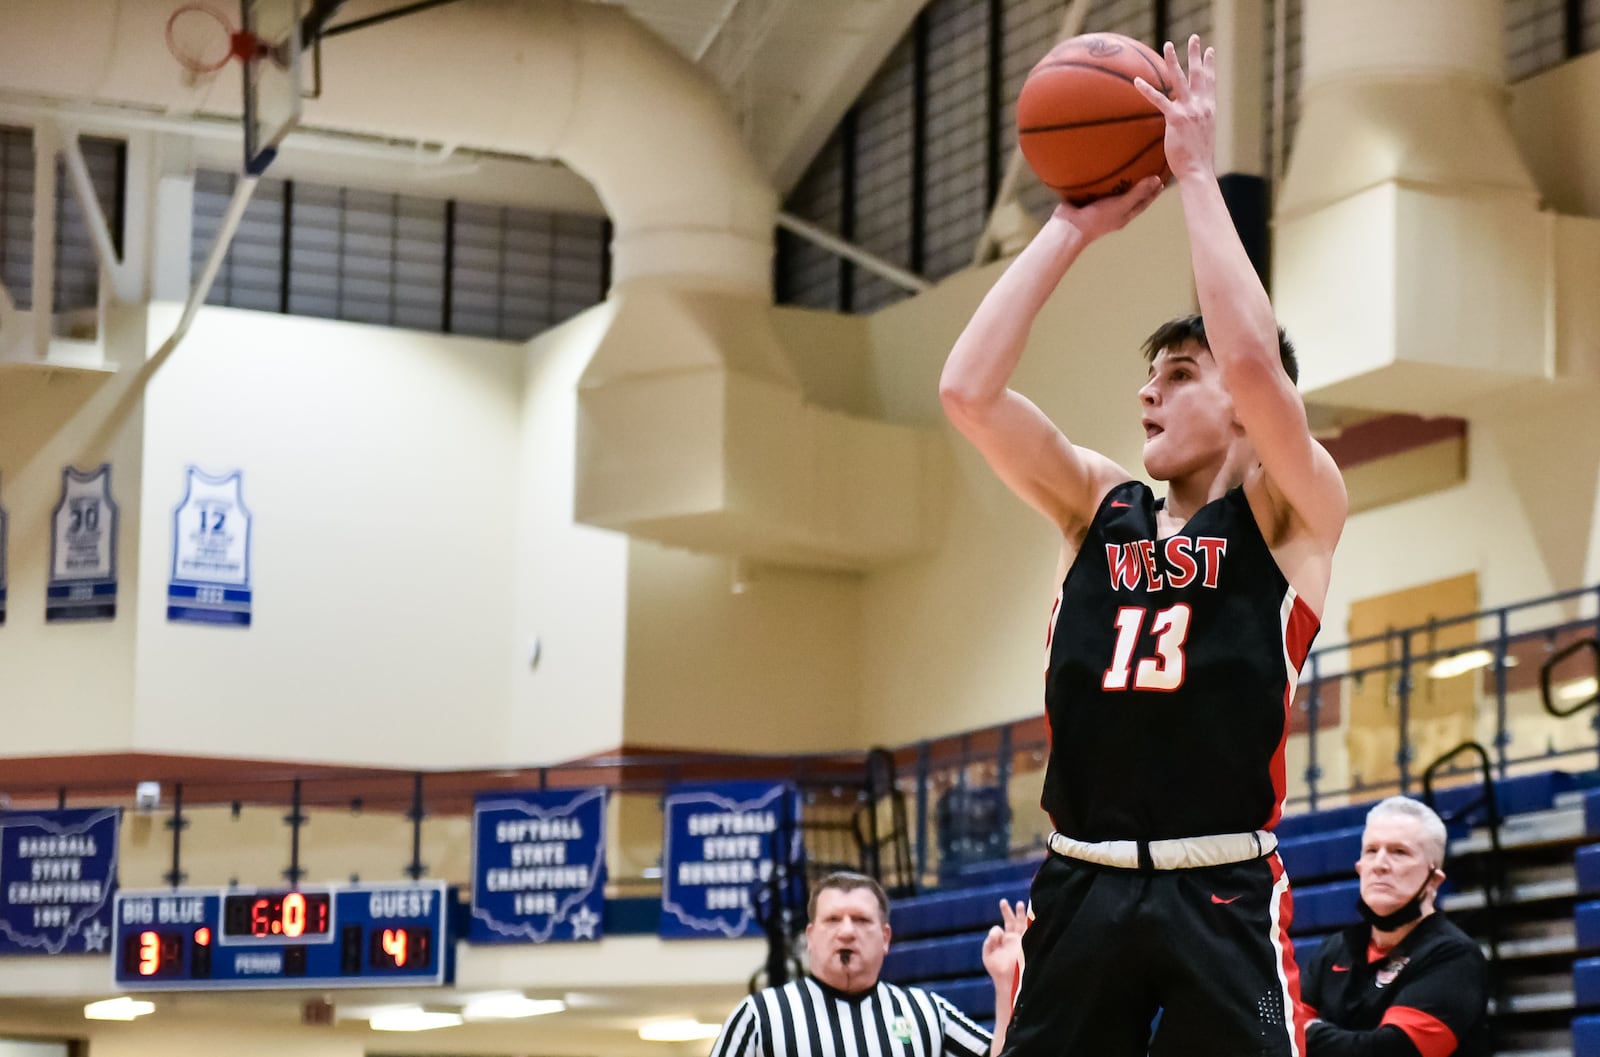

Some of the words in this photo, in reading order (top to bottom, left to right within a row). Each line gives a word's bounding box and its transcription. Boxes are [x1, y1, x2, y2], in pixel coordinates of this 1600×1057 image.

[200, 508, 226, 533] 12
[1105, 535, 1227, 592] WEST
[1101, 602, 1192, 693] 13
[496, 818, 583, 843] SOFTBALL
[688, 811, 776, 837] SOFTBALL
[19, 835, 97, 858] BASEBALL
[511, 842, 566, 867] STATE
[703, 836, 760, 860] STATE
[31, 858, 81, 881] STATE
[487, 865, 589, 893] CHAMPIONS
[8, 880, 101, 904] CHAMPIONS
[33, 905, 71, 928] 1997
[123, 898, 154, 925] BIG
[158, 897, 206, 924] BLUE
[369, 891, 433, 919] GUEST
[235, 952, 283, 974] PERIOD
